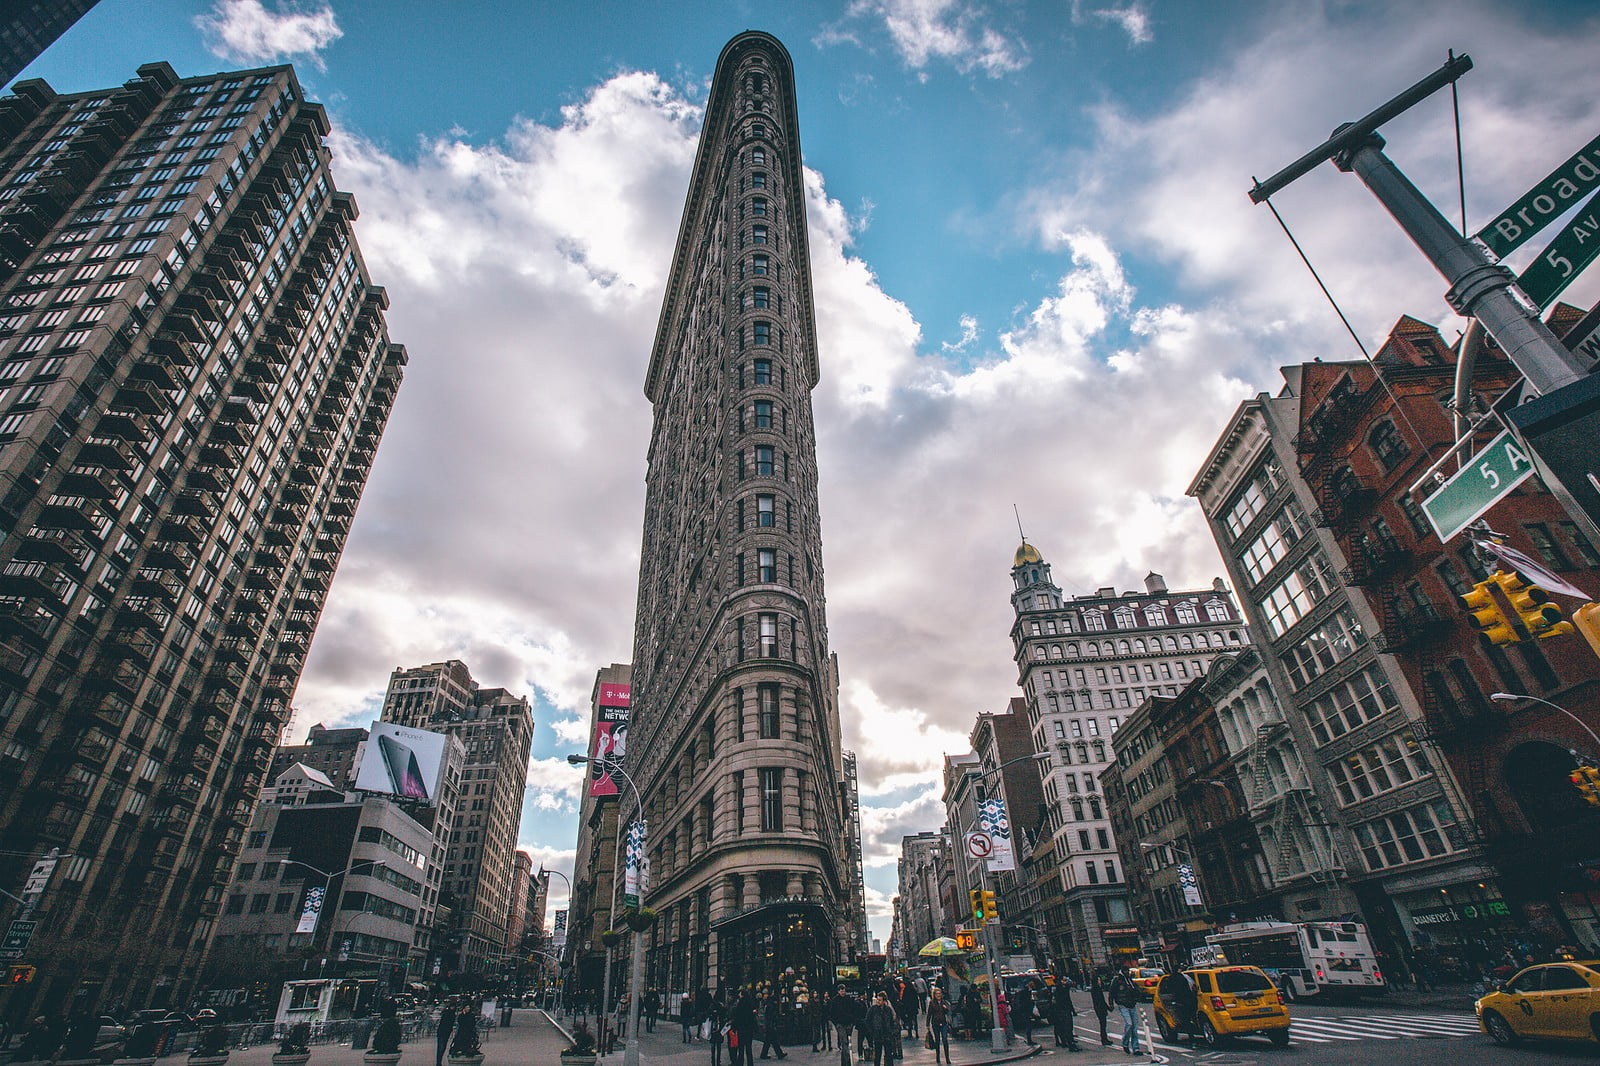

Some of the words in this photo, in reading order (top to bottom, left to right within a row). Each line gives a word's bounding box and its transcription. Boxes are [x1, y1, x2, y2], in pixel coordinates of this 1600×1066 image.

[1494, 149, 1600, 242] Broad
[1545, 249, 1573, 278] 5
[1572, 214, 1600, 244] Av
[1479, 462, 1500, 489] 5
[8, 930, 31, 938] Streets
[965, 936, 974, 949] 8
